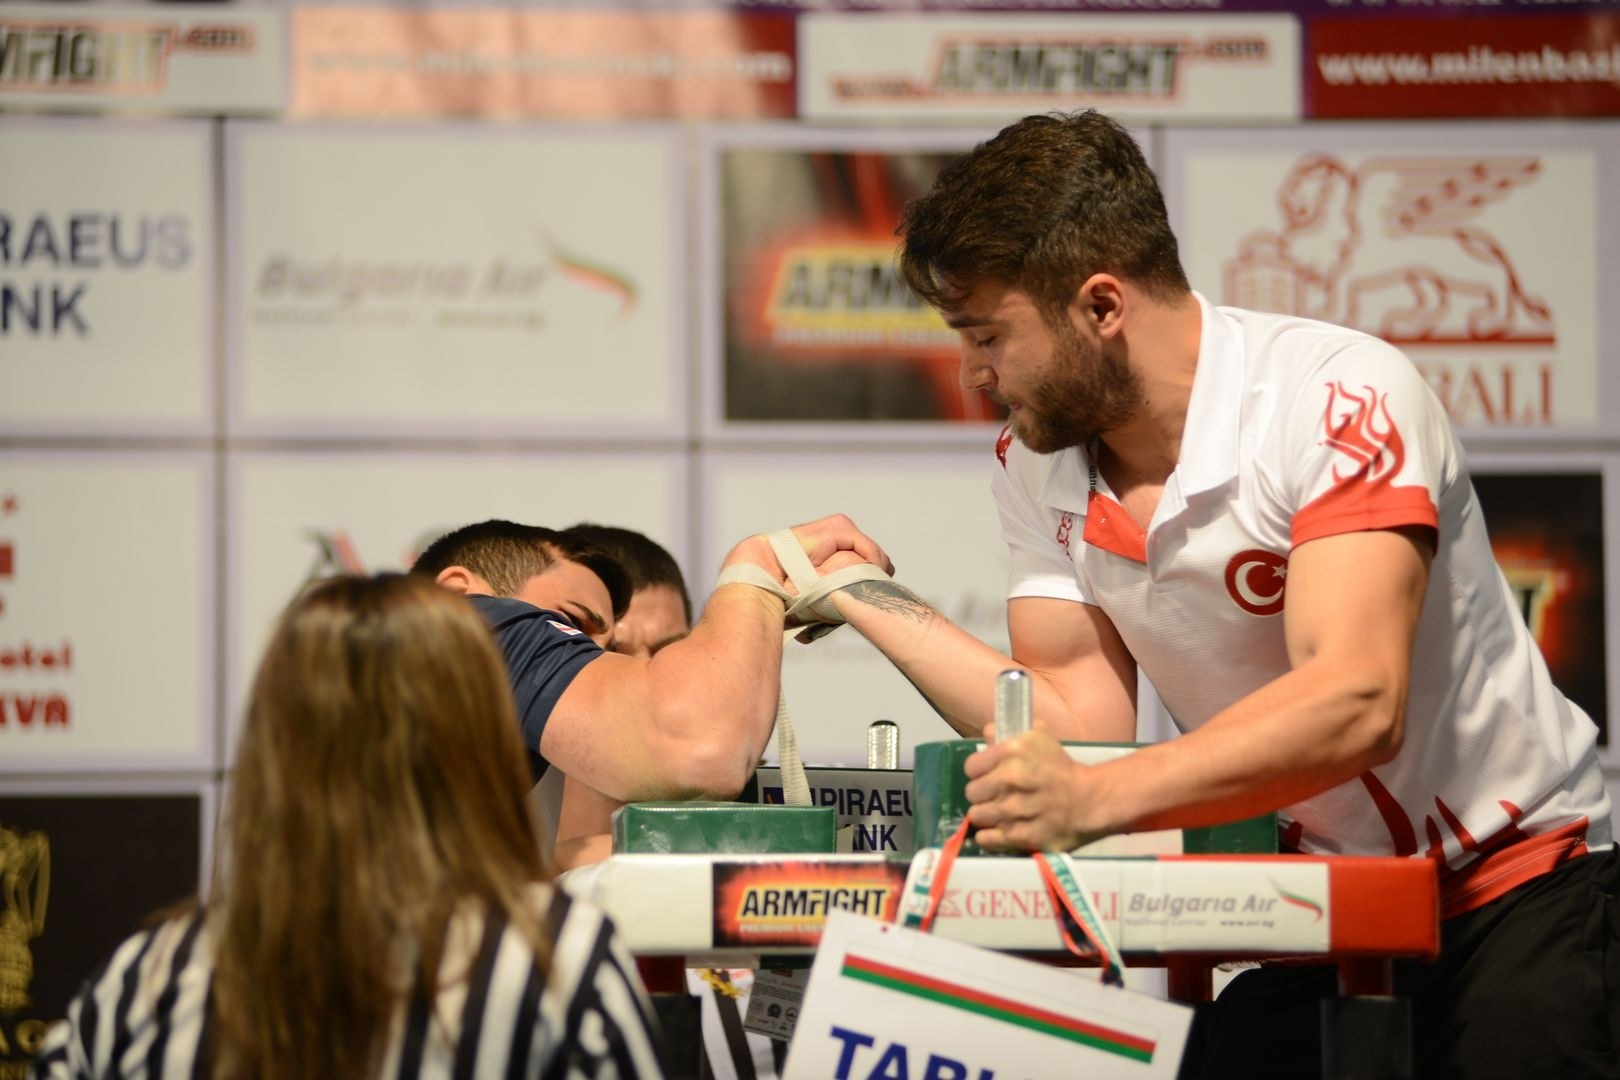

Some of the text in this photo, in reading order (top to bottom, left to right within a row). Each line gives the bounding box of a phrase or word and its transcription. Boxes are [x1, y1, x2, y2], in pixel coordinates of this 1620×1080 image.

[936, 41, 1181, 97] ARMFIGHT
[0, 694, 69, 726] VA
[742, 889, 888, 917] ARMFIGHT
[1128, 893, 1278, 917] Bulgaria Air
[830, 1025, 994, 1080] TA
